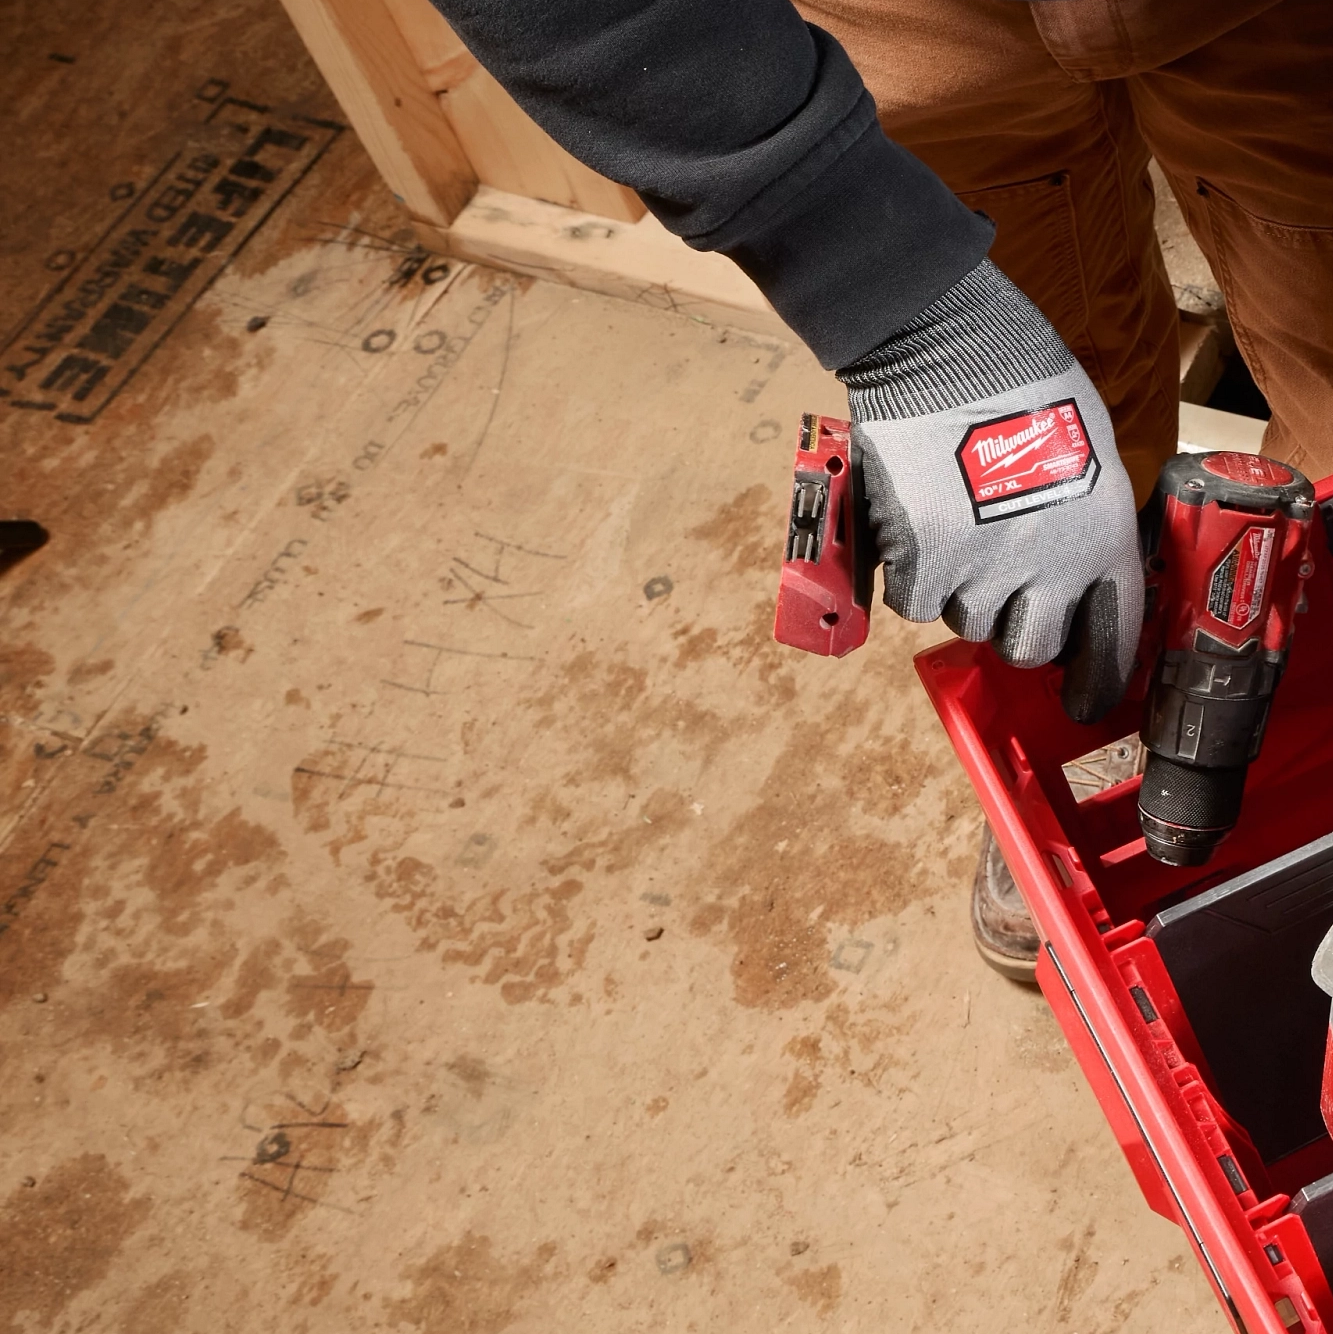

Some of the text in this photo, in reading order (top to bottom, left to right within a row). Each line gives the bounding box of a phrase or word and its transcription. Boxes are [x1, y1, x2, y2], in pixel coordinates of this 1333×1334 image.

[971, 416, 1056, 467] Milwaukee
[1005, 479, 1022, 492] XL
[998, 499, 1022, 513] CUT
[1025, 489, 1057, 507] LEVEL
